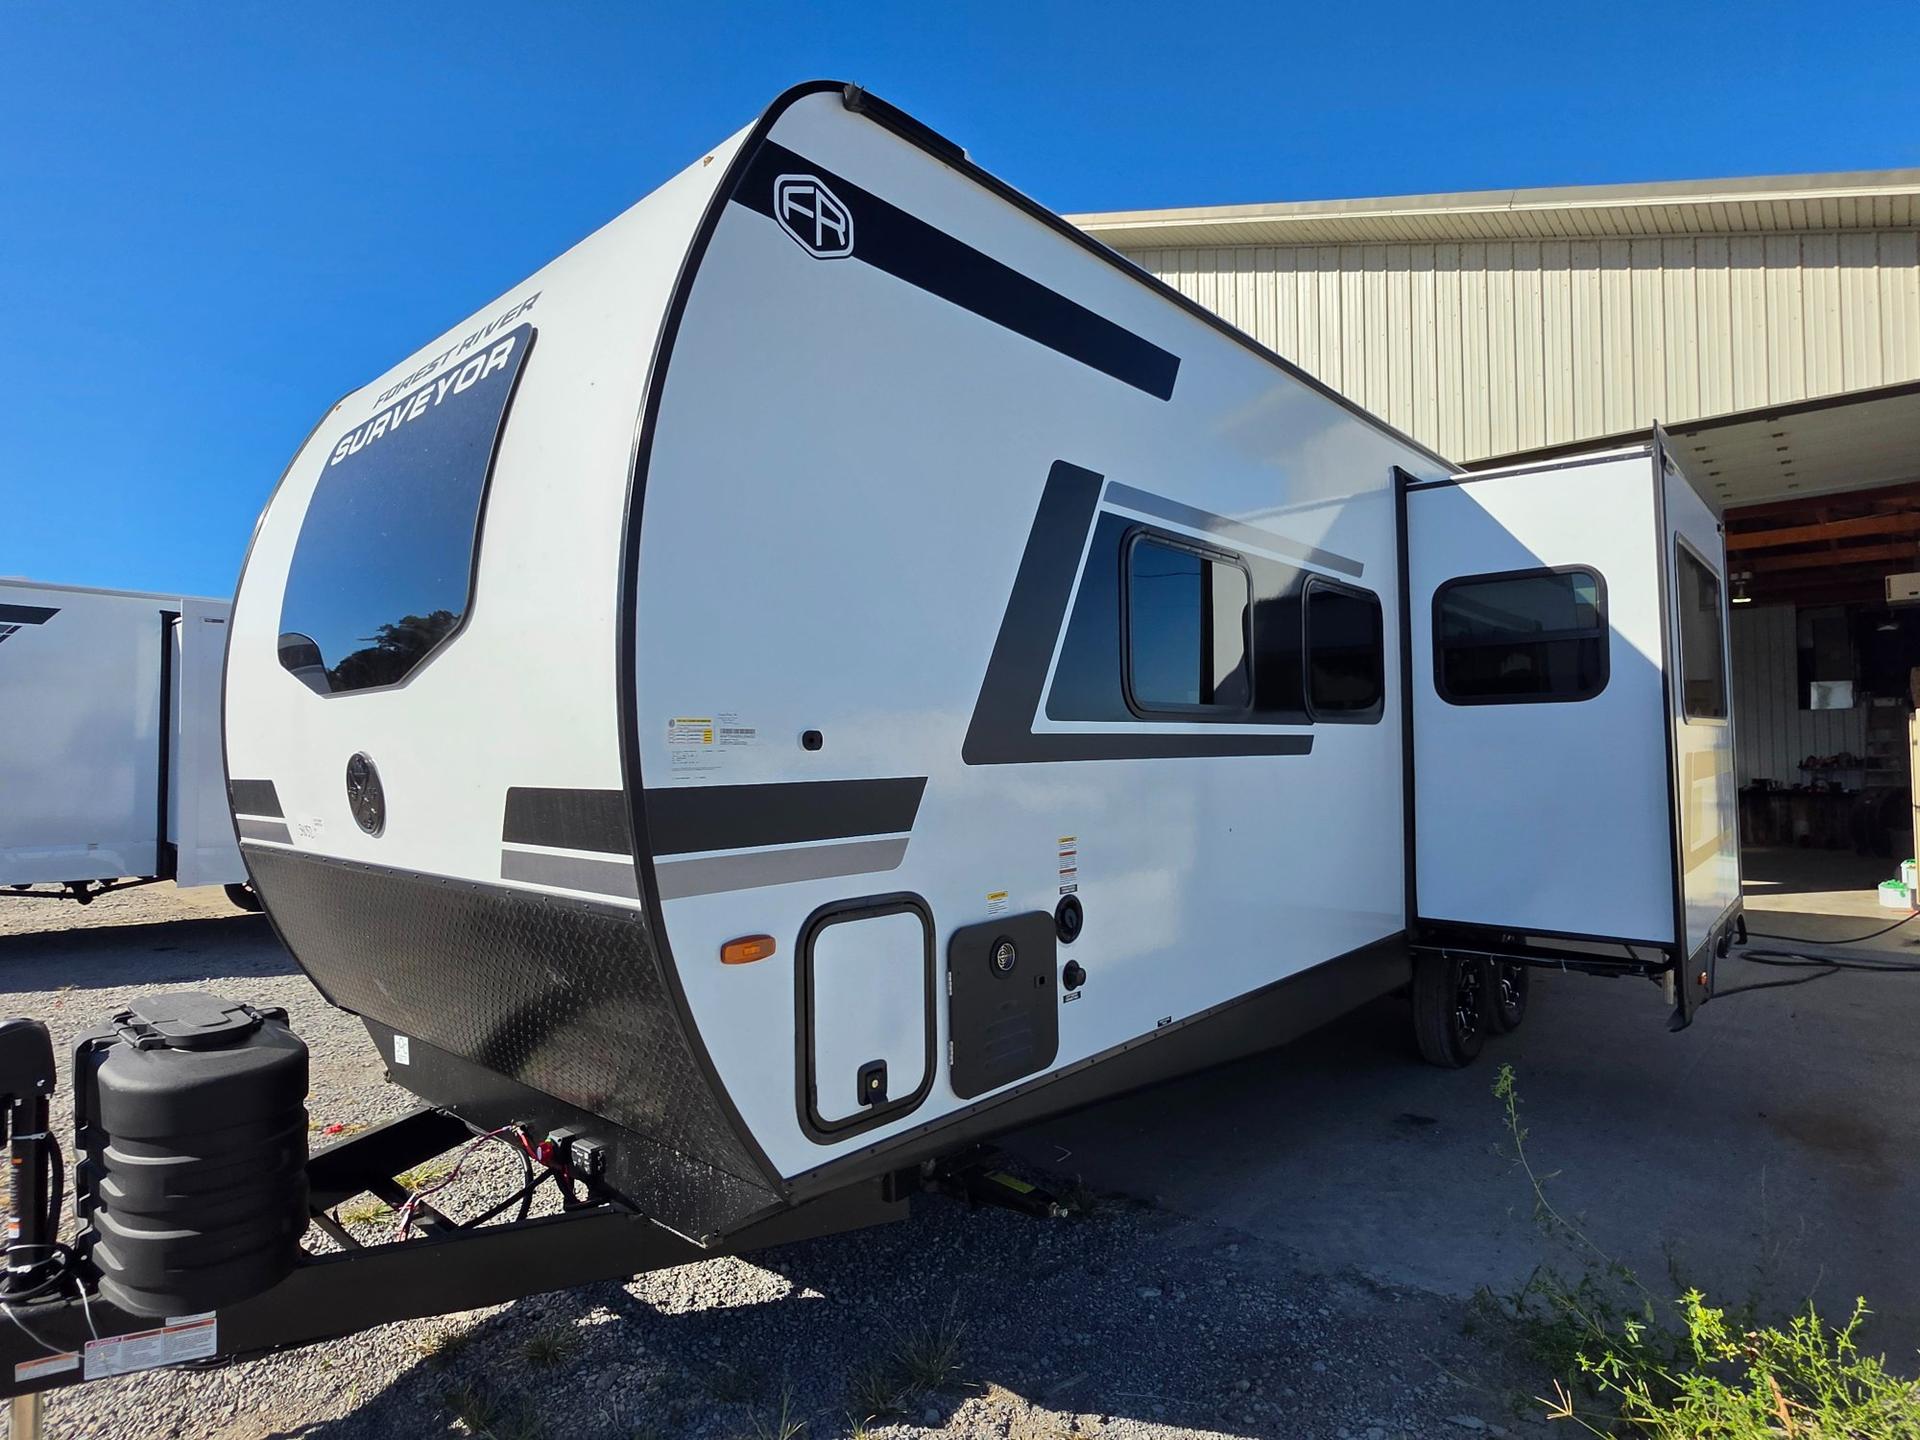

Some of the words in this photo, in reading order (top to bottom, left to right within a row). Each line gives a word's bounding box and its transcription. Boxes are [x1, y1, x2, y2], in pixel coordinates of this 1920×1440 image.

[330, 336, 516, 466] SURVEYOR
[372, 344, 459, 411] FOREST
[456, 290, 543, 356] RIVER
